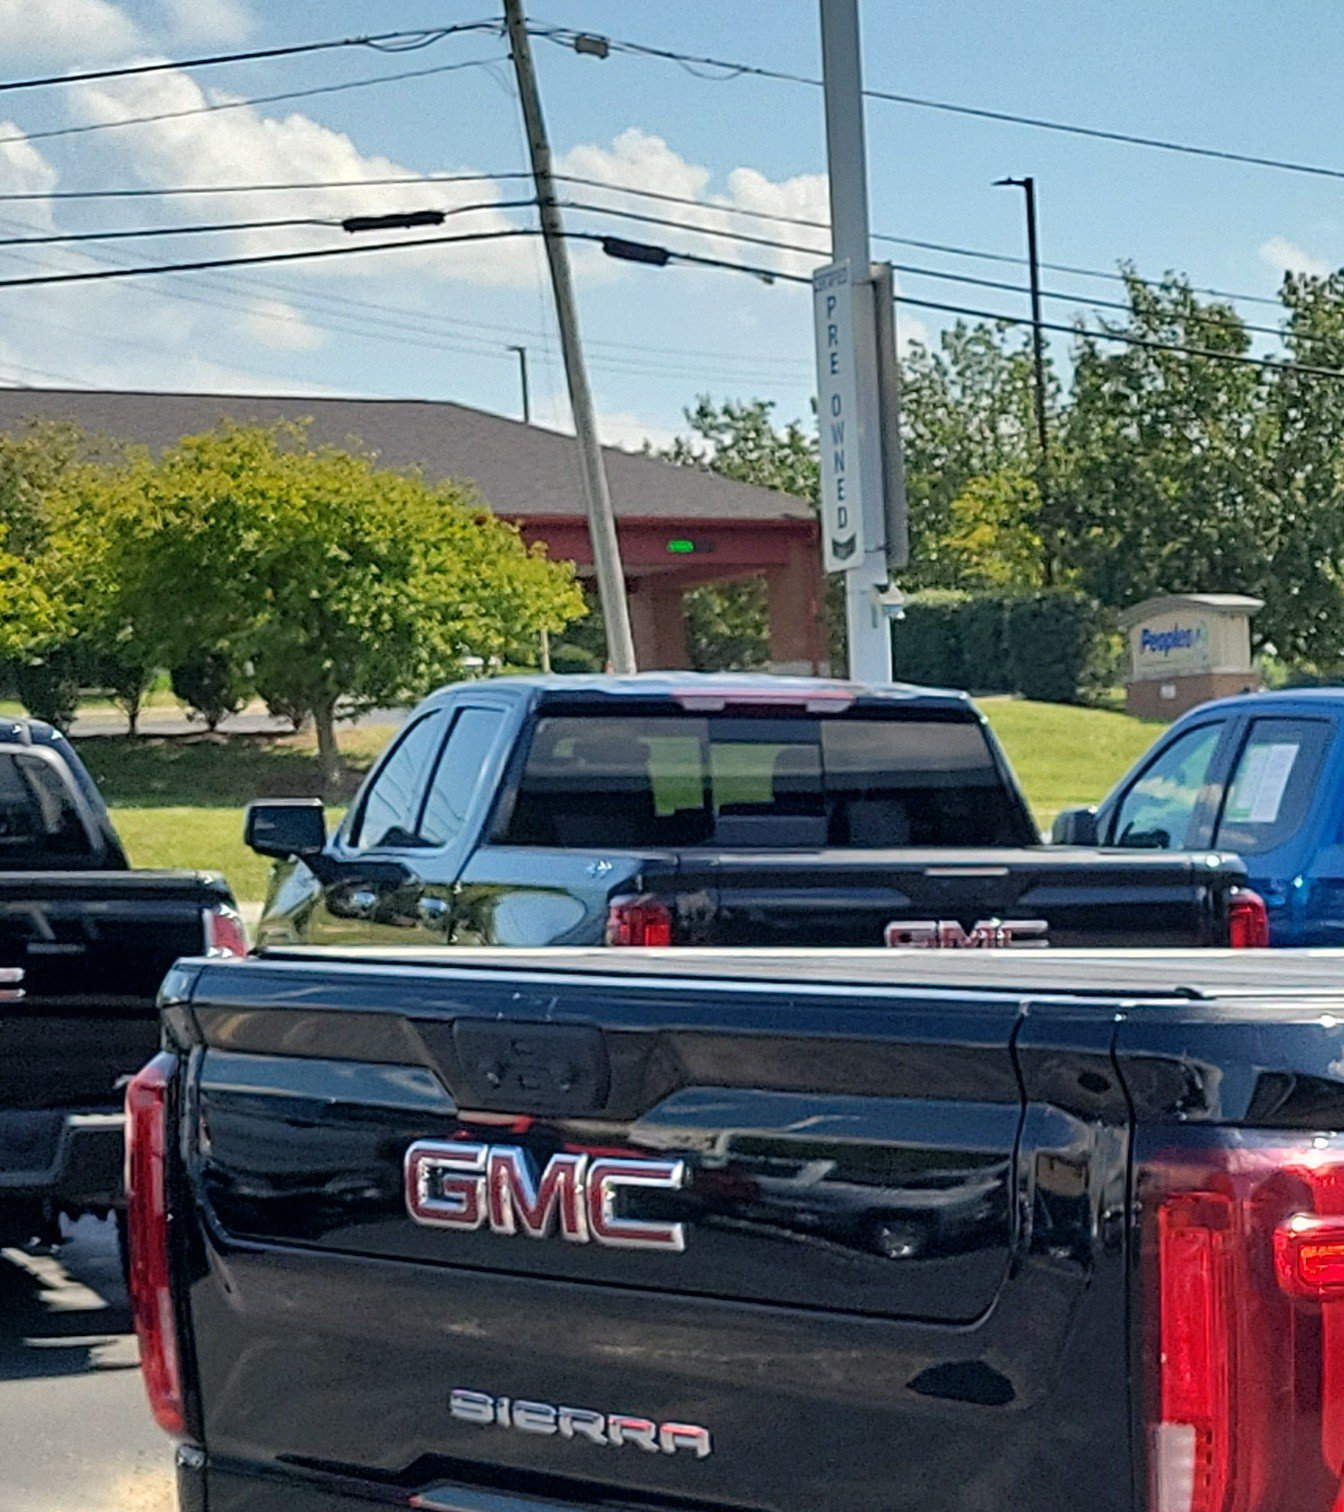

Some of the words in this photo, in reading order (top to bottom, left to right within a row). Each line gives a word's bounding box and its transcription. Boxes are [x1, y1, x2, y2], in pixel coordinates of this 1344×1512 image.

[826, 295, 840, 375] PRE
[831, 393, 846, 529] OWNED
[884, 917, 1049, 948] GMC
[404, 1139, 689, 1253] GMC
[450, 1388, 712, 1459] SIERRA
